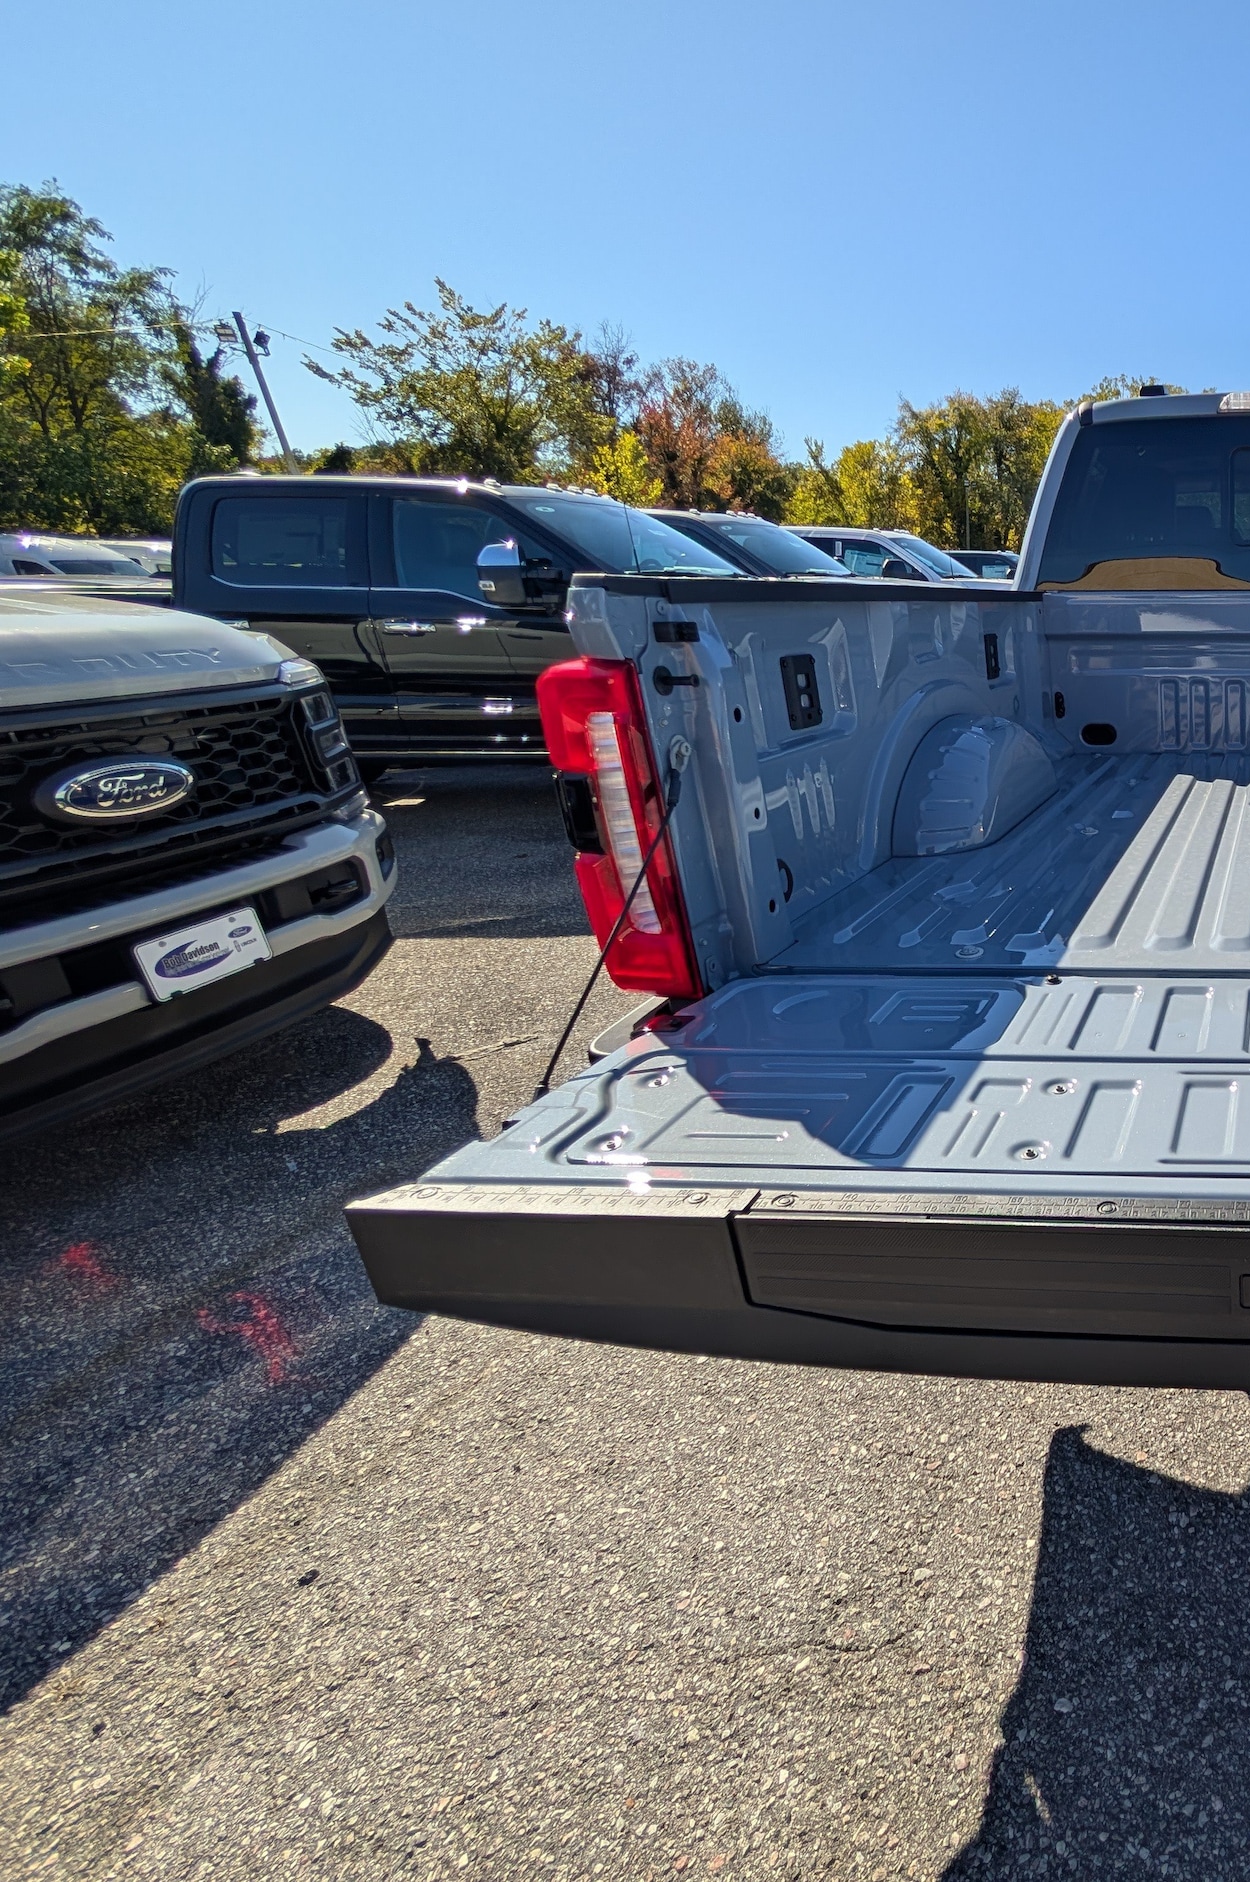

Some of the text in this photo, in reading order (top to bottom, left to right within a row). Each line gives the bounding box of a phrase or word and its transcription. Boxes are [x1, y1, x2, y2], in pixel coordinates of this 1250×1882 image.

[71, 649, 222, 673] DUTY
[98, 773, 168, 807] Ford
[163, 955, 182, 968] Bob
[182, 942, 220, 961] Davidson
